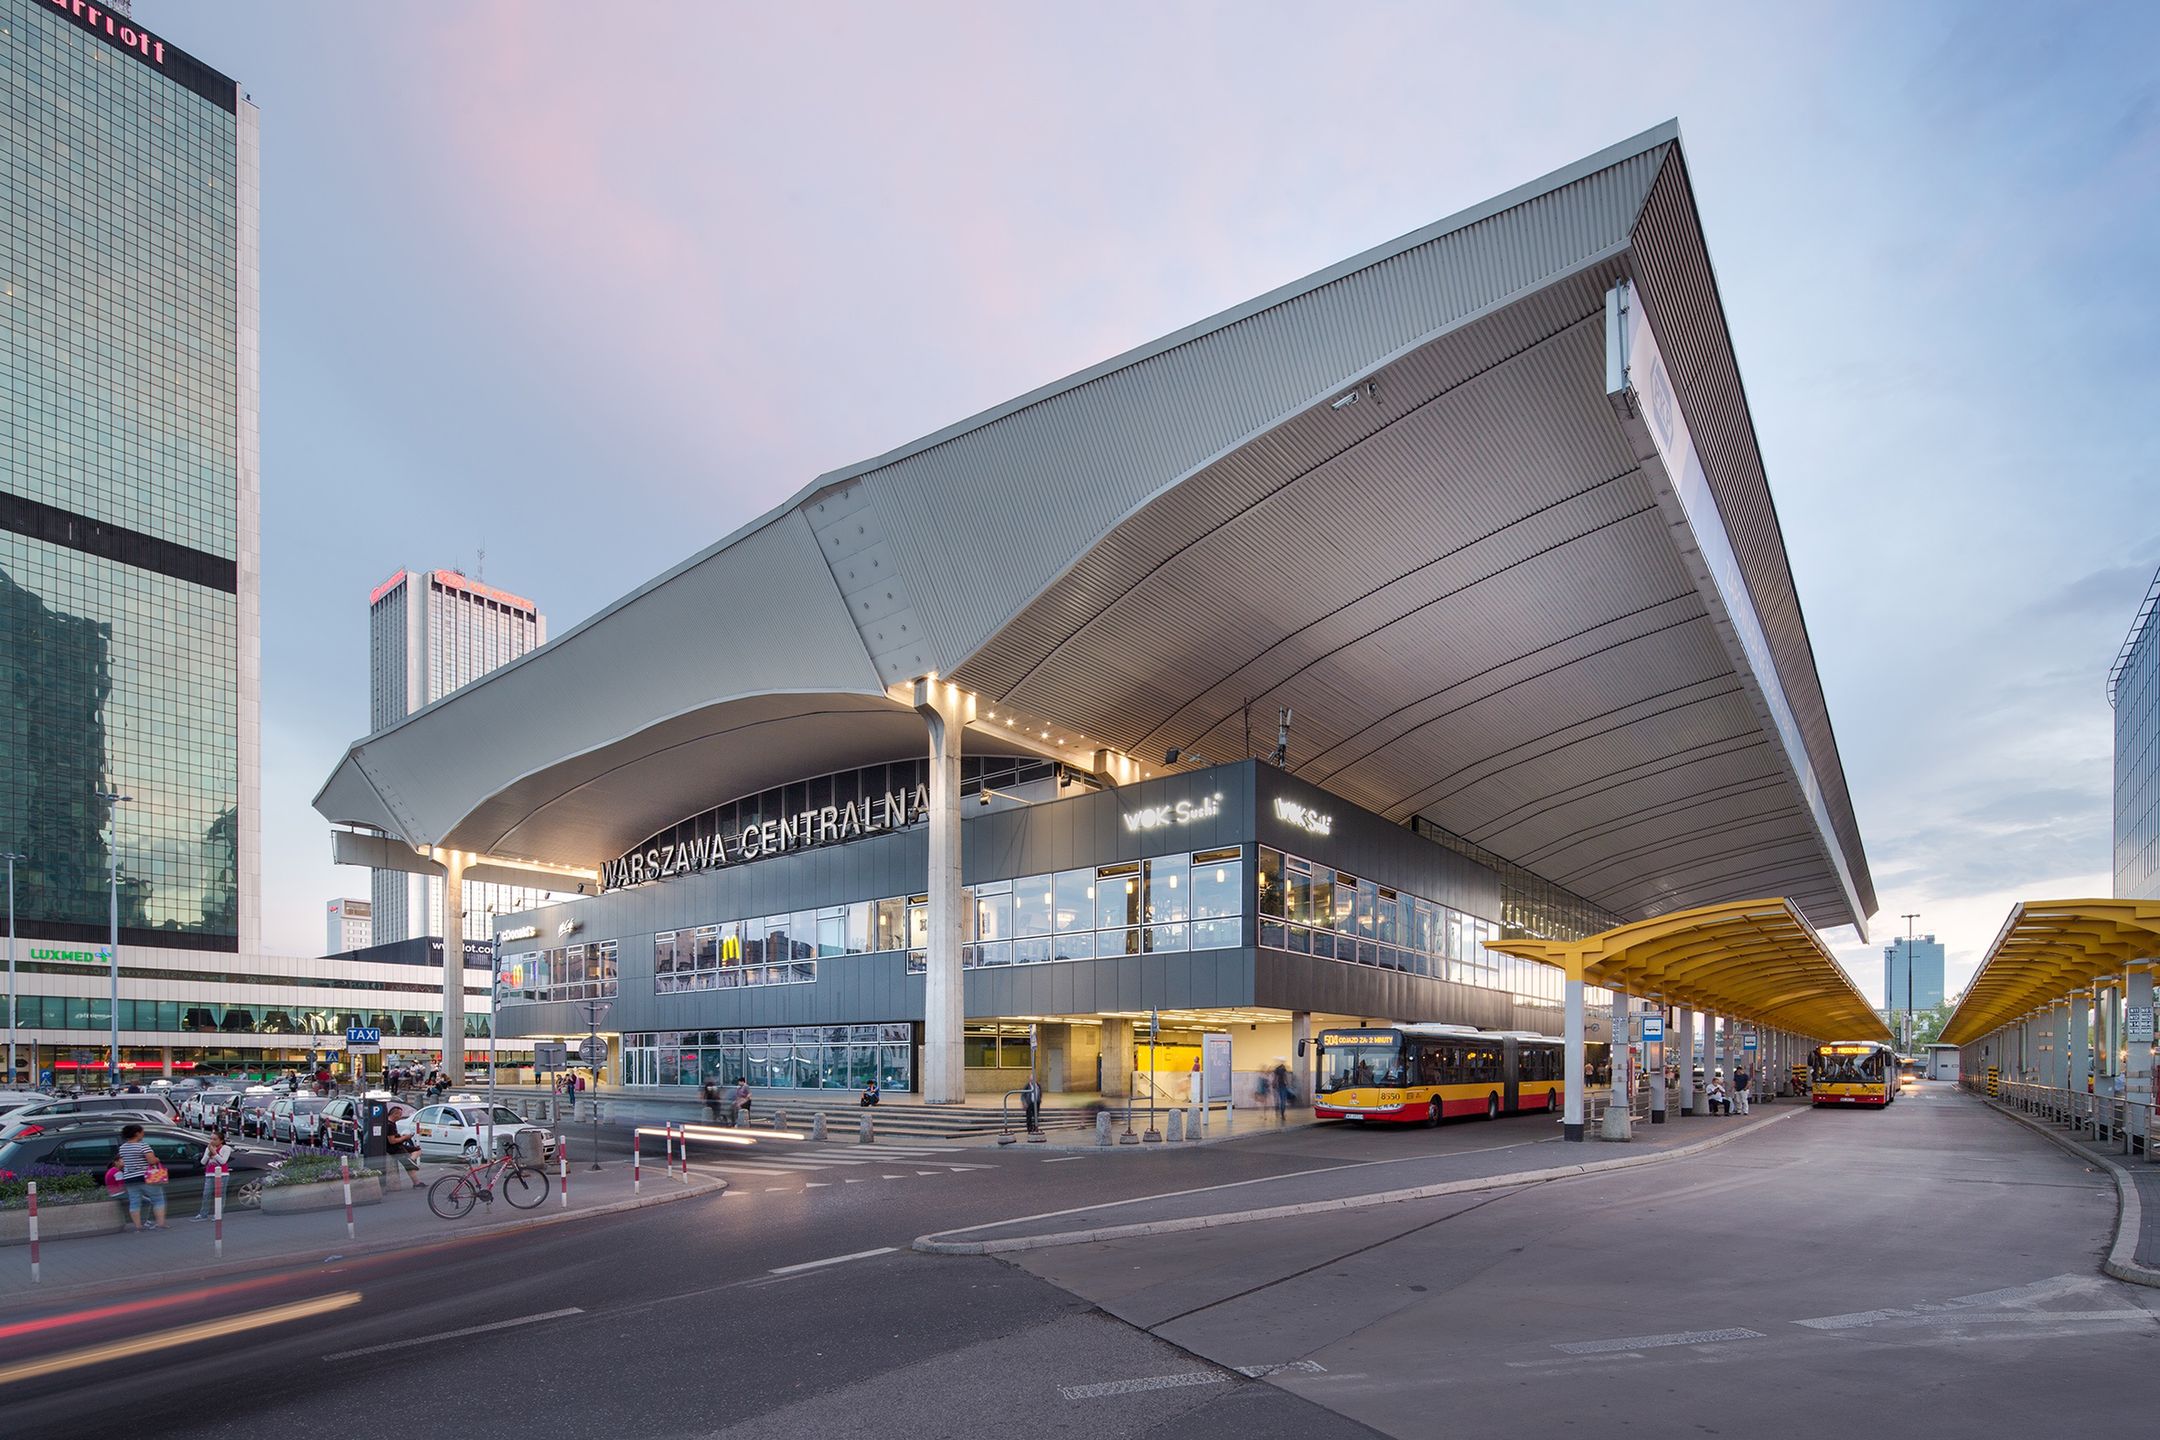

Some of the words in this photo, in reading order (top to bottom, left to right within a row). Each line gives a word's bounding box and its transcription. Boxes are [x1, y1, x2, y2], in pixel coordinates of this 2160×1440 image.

[1124, 804, 1170, 831] WOK
[1176, 797, 1218, 823] Sushi
[600, 833, 726, 888] WARSZAWA
[740, 783, 930, 859] CENTRALNA
[31, 948, 94, 962] LUXMED
[349, 1030, 378, 1040] TAXI
[1381, 1092, 1400, 1100] 8550
